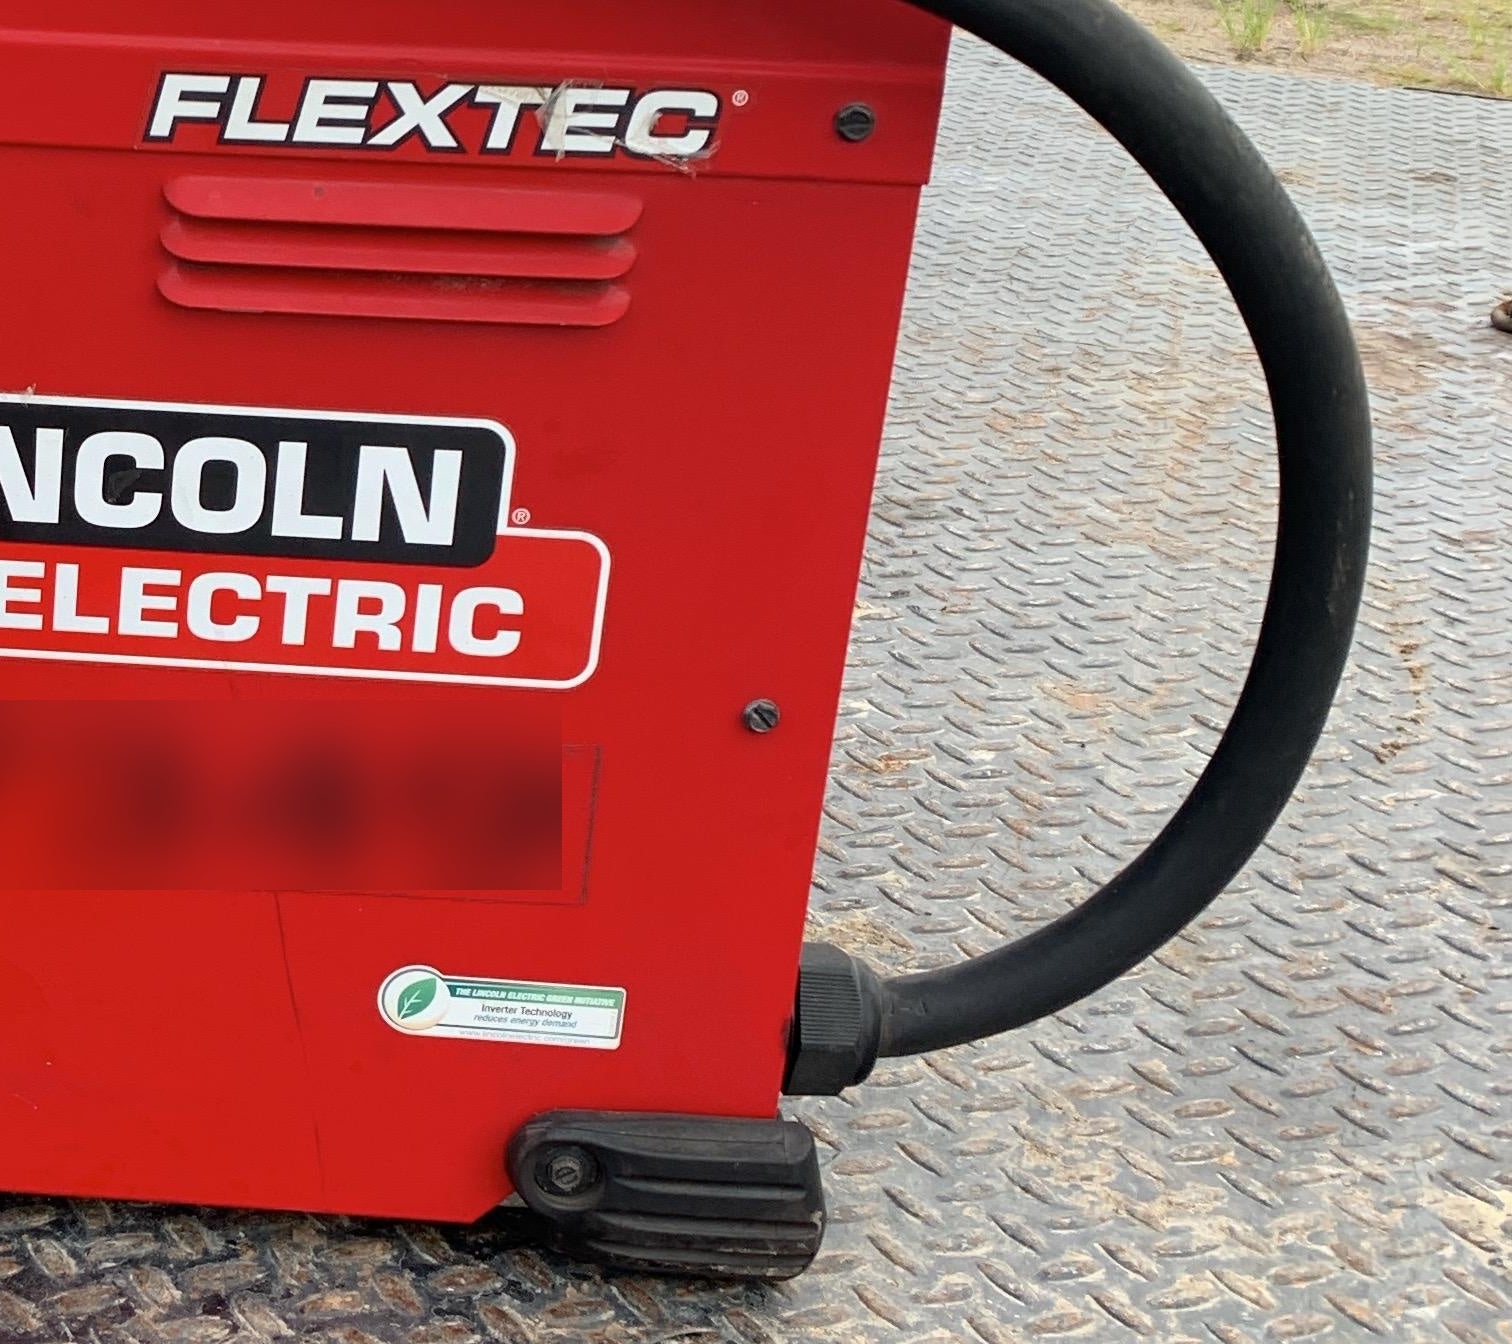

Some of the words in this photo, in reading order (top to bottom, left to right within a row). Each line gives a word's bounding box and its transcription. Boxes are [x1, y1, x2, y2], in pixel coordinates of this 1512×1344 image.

[147, 72, 720, 155] FLEXTEC
[456, 987, 472, 997] THE
[472, 989, 507, 999] LINCOLN
[507, 991, 545, 1002] ELECTRIC
[546, 994, 573, 1004] GREEN
[481, 1003, 517, 1015] Inverter
[520, 1006, 573, 1019] Technology
[473, 1014, 507, 1024] reduces
[510, 1017, 539, 1027] energy
[541, 1018, 578, 1028] demand
